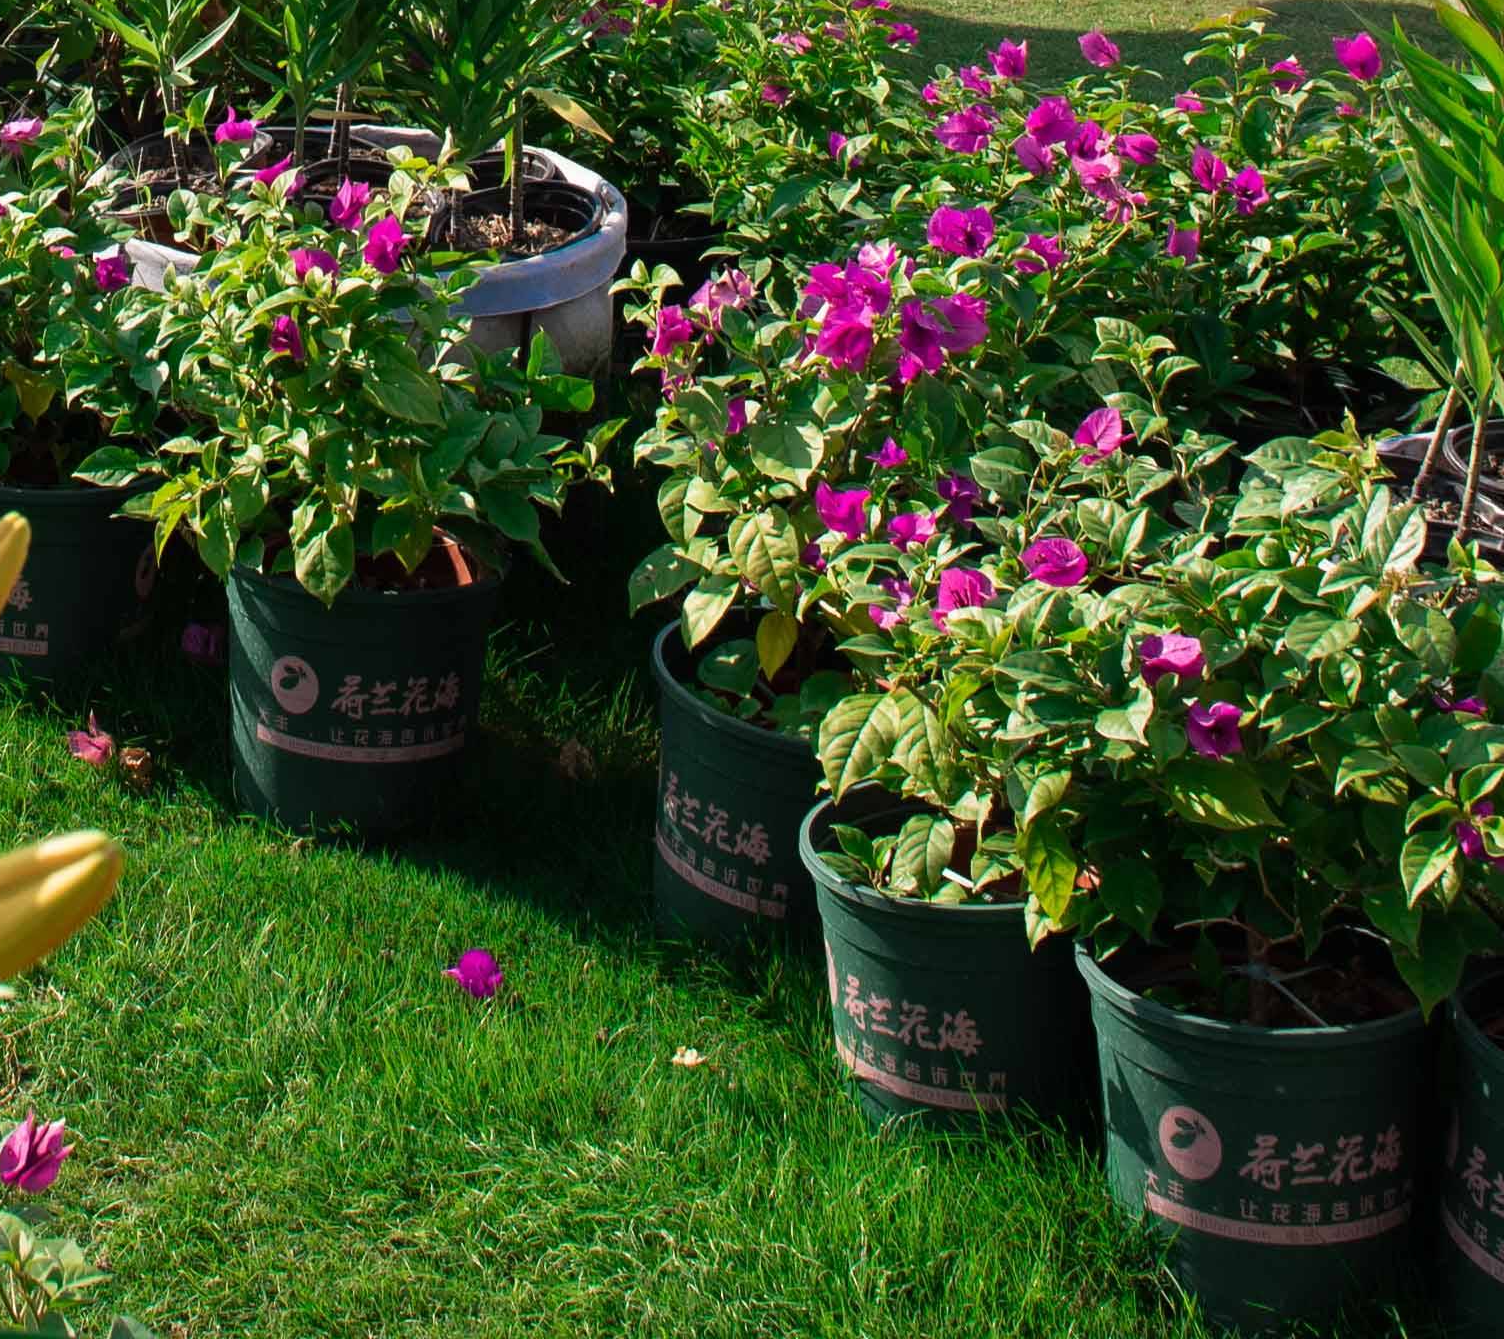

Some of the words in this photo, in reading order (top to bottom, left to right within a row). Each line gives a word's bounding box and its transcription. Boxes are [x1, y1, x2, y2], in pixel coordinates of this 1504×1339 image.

[330, 671, 461, 720] 荷兰花海
[843, 973, 984, 1058] 荷兰花海
[1238, 1122, 1403, 1192] 荷兰花海
